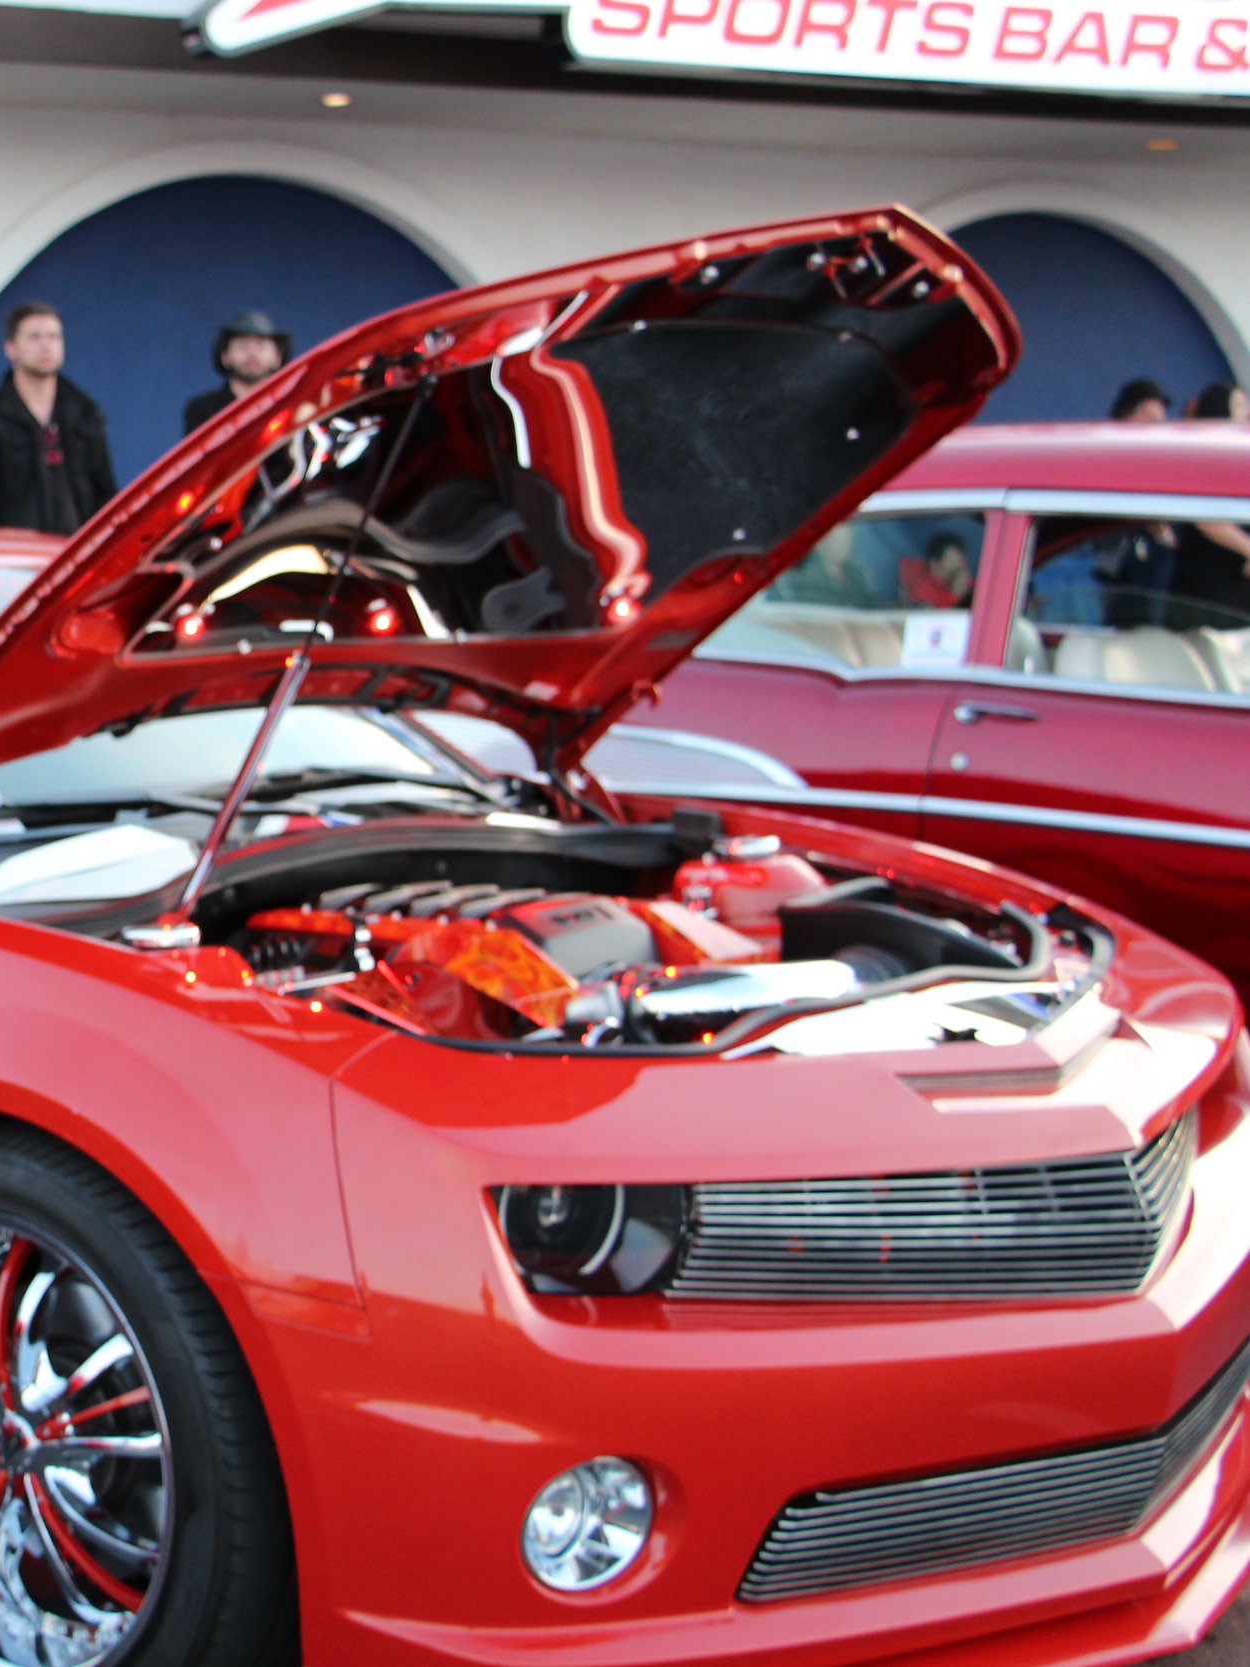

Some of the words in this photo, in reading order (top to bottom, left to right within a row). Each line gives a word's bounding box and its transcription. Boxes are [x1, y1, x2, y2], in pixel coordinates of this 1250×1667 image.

[591, 0, 975, 58] SPORTS
[993, 6, 1180, 70] BAR
[1196, 18, 1250, 71] &
